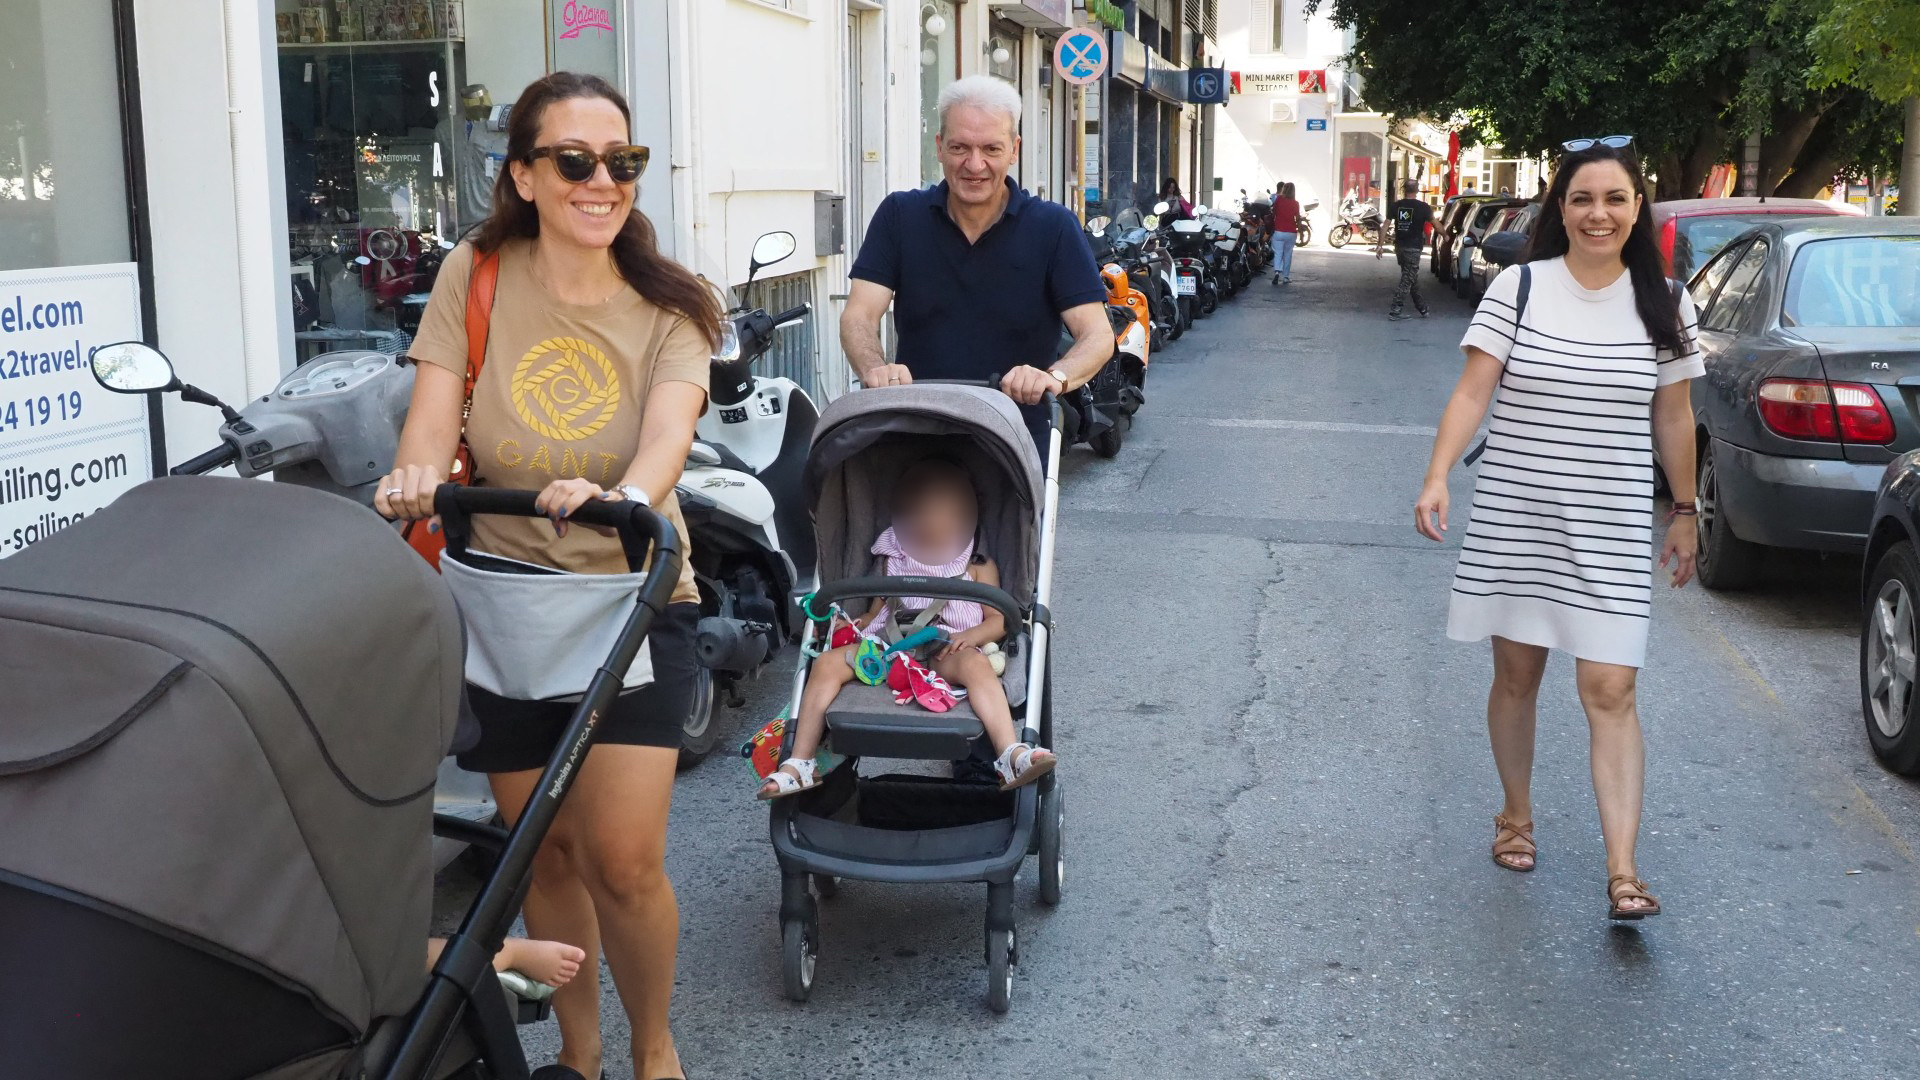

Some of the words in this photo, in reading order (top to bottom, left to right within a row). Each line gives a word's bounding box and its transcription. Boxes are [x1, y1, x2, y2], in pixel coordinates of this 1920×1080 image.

[1246, 74, 1263, 82] MINI
[1265, 74, 1293, 82] MARKET
[2, 295, 83, 332] el.com
[0, 401, 18, 431] 4
[25, 396, 50, 426] 19
[57, 390, 82, 420] 19
[497, 439, 618, 480] GANT
